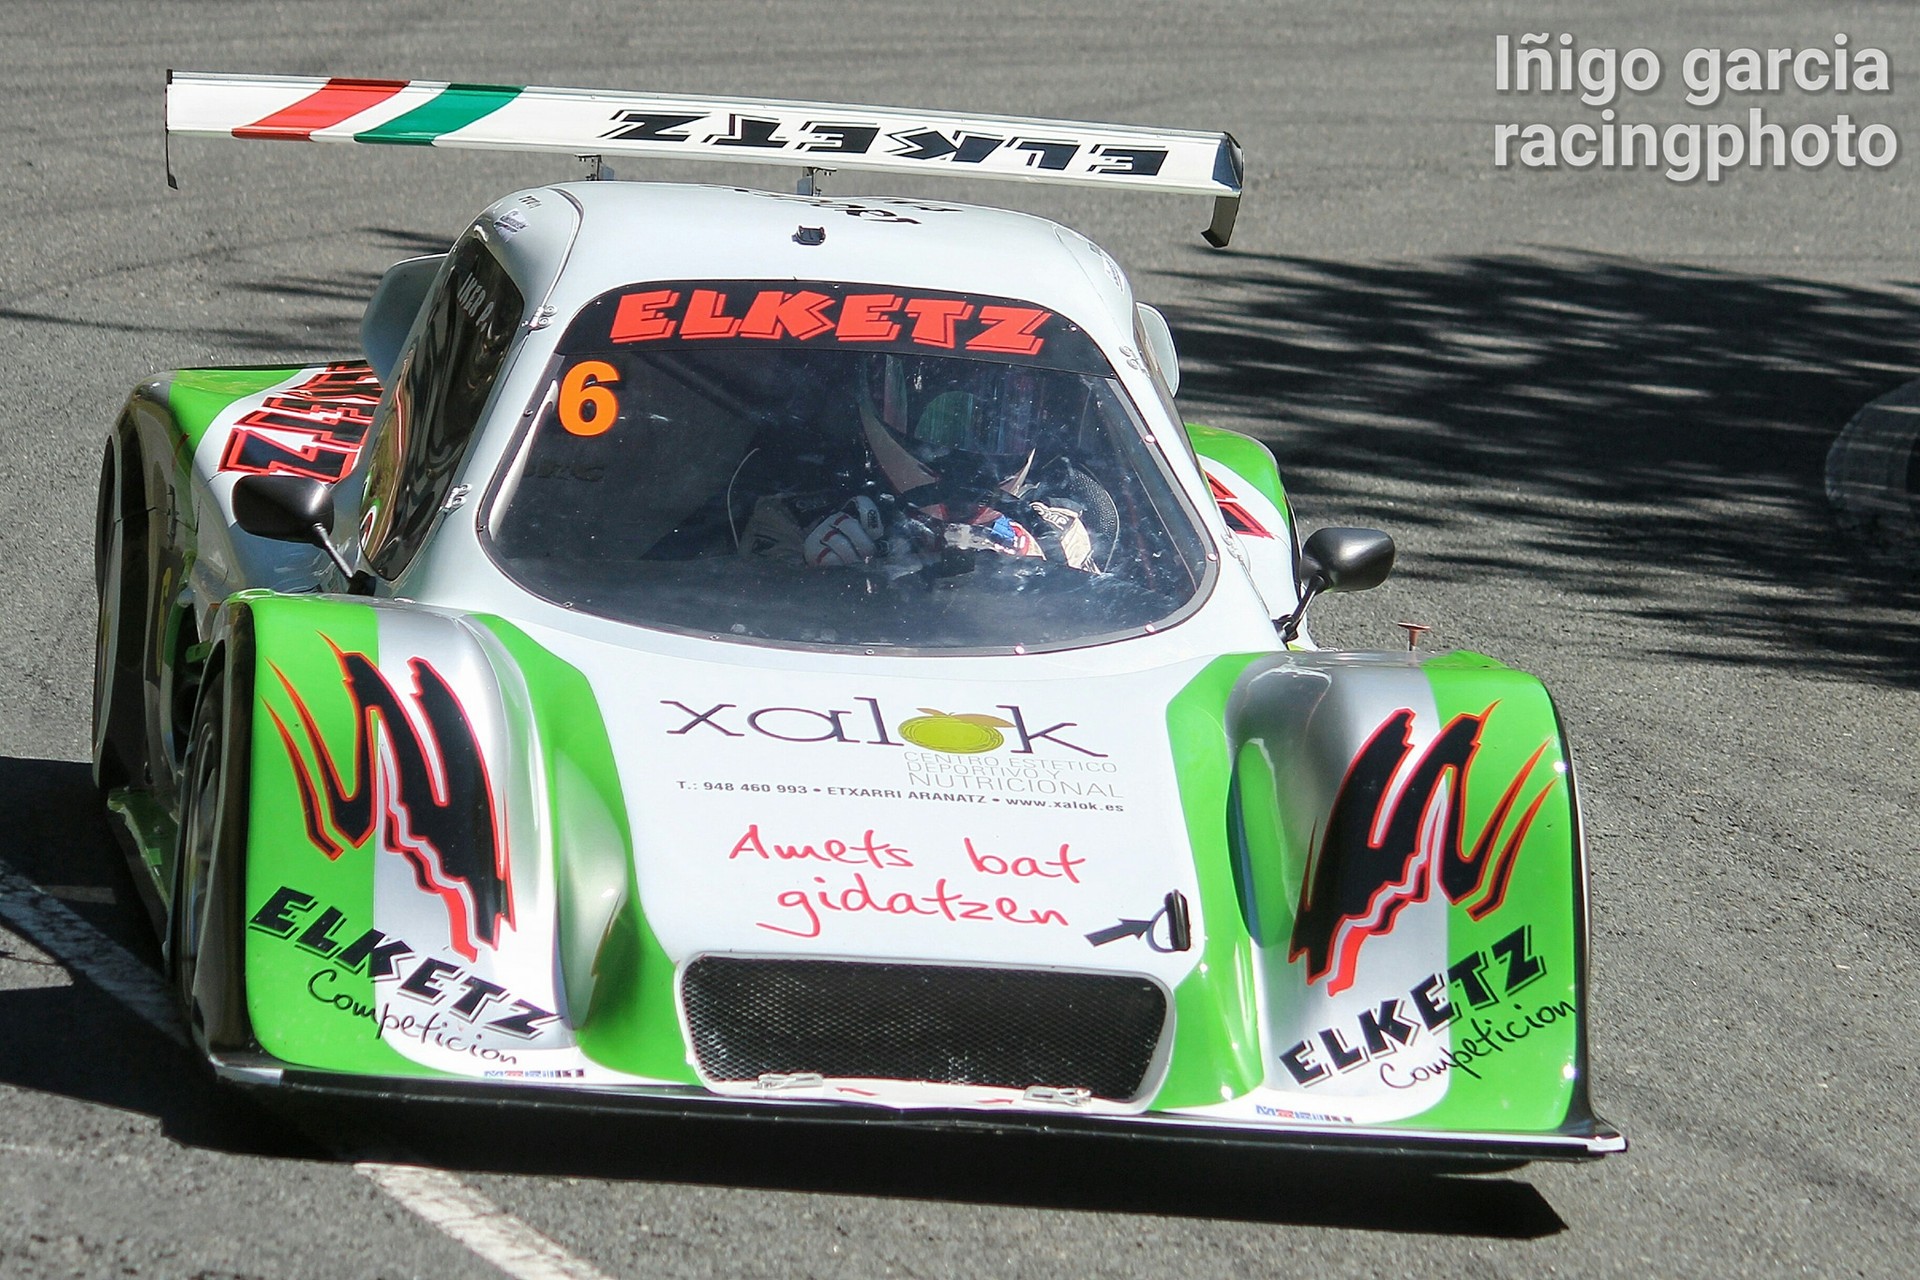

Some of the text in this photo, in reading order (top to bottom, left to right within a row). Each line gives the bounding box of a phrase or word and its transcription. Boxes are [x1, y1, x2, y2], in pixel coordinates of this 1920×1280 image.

[599, 109, 1169, 177] ELKETZ
[609, 290, 1053, 356] ELKETZ
[558, 361, 620, 436] 6
[904, 752, 1118, 774] CENTRO ESTETICO
[907, 762, 1039, 780] DEPORTIVO
[908, 772, 1125, 799] NUTRICIONAL
[703, 781, 735, 792] 948
[741, 783, 771, 793] 460
[777, 784, 808, 795] 993
[827, 786, 902, 799] ETXARRI
[908, 790, 988, 805] ARANATZ
[1006, 798, 1125, 813] www.xalok.es
[729, 824, 1087, 884] Amets bat
[756, 873, 1069, 938] gidatzen
[248, 885, 565, 1041] ELKETZ
[307, 969, 517, 1066] Competicion
[1278, 924, 1548, 1088] ELKETZ
[1379, 999, 1577, 1090] Competicion
